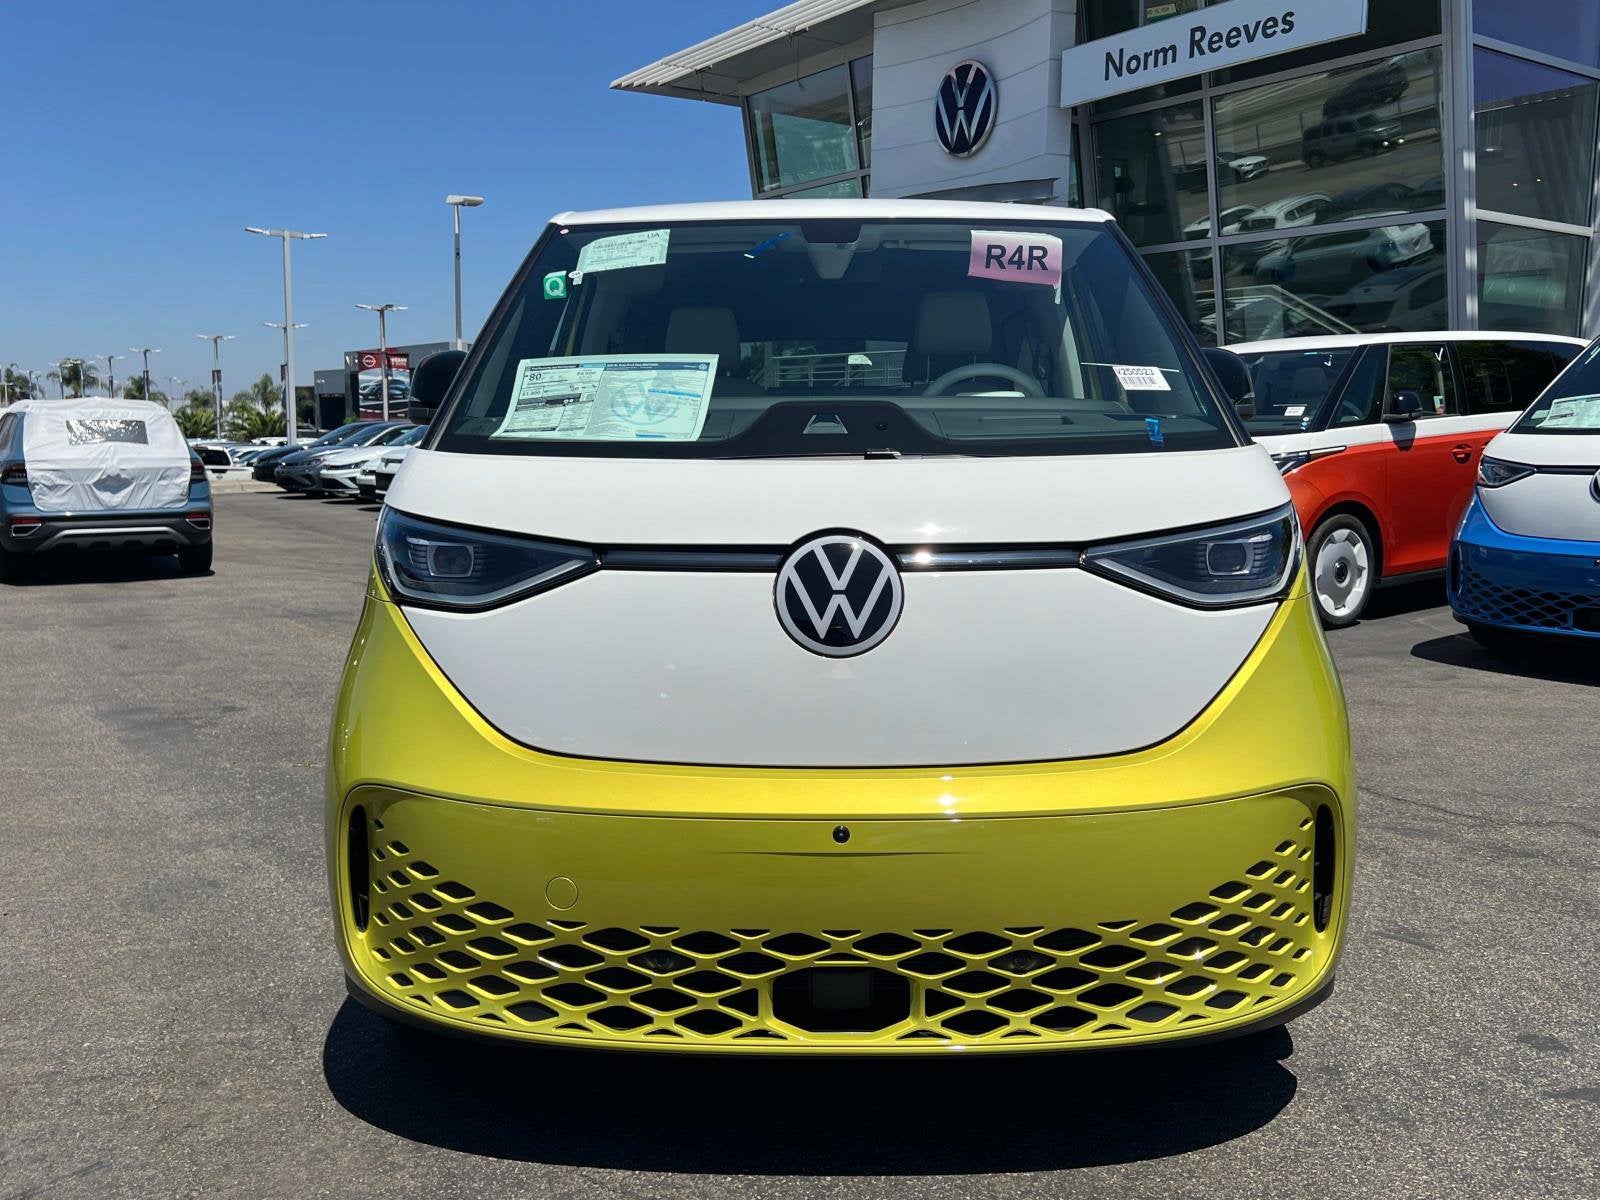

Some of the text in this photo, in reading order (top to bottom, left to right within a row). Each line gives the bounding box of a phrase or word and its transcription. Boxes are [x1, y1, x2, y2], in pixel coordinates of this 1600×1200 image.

[1104, 10, 1295, 81] Norm Reeves
[936, 60, 995, 153] VW
[985, 244, 1048, 271] R4R
[545, 277, 565, 297] Q
[528, 373, 542, 381] 80
[778, 536, 900, 655] VW
